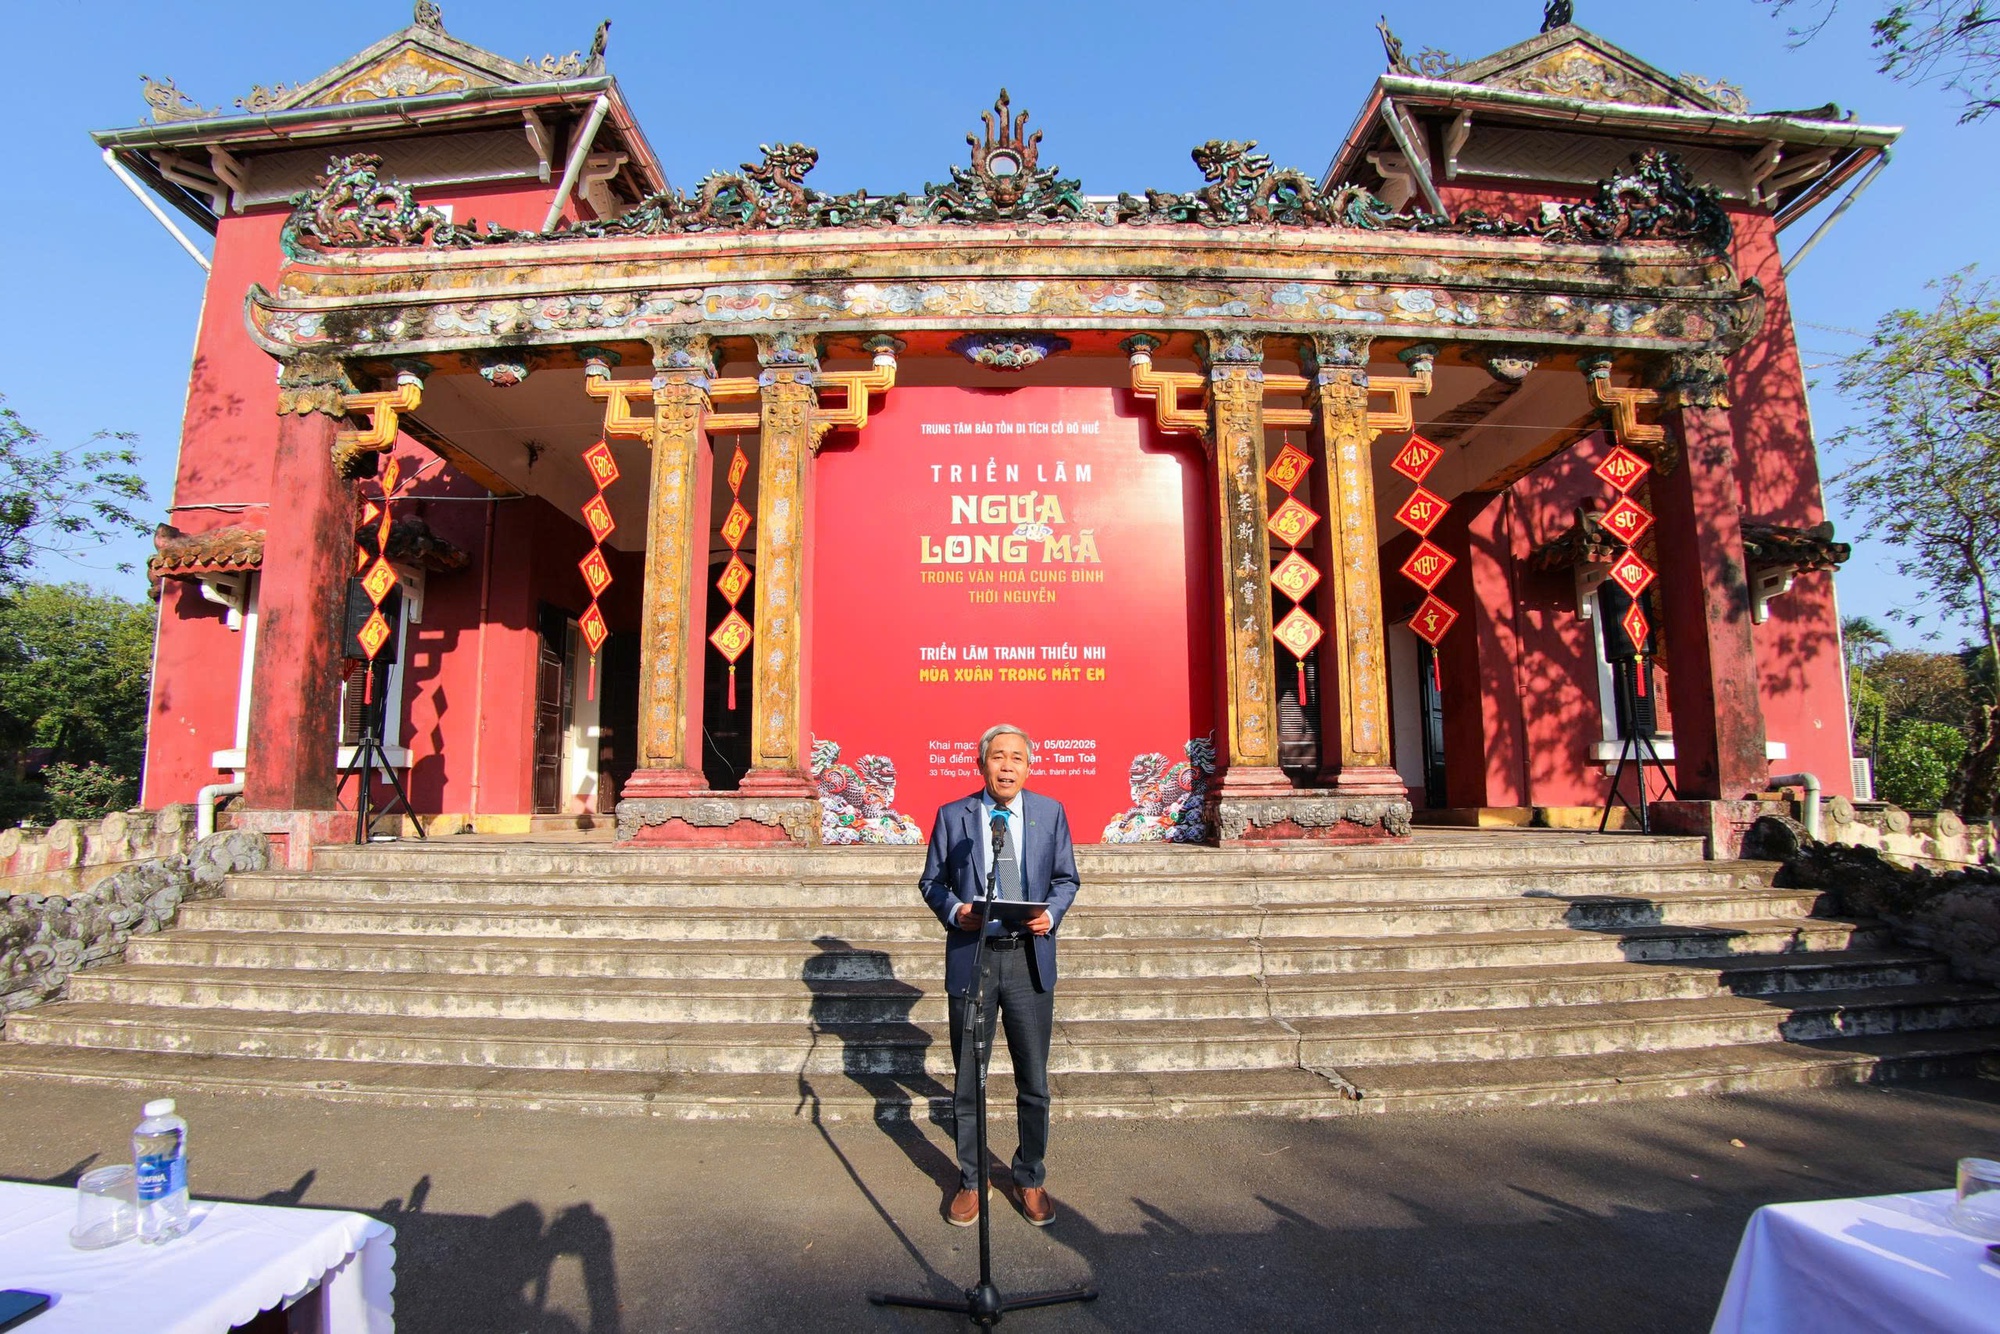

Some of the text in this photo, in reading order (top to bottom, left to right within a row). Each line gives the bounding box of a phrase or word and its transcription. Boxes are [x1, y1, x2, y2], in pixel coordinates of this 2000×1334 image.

[921, 423, 951, 434] TRUNG
[953, 421, 972, 434] TÂM
[975, 420, 993, 434] BẢO
[1016, 423, 1026, 434] DI
[1028, 420, 1049, 434] TÍCH
[1081, 419, 1100, 434] HUẾ
[592, 454, 613, 478] CHÚC
[931, 457, 1092, 483] TRIỂN LÃM
[1606, 457, 1635, 482] VẠN
[920, 529, 1102, 564] LONG MÃ
[1403, 446, 1429, 472] VẠN
[1423, 609, 1440, 632] Ý
[920, 568, 1104, 584] TRONG VĂN HOÁ CUNG ĐÌNH
[968, 586, 1056, 603] THỜI NGUYỄN
[920, 642, 1106, 660] TRIỂN LÃM TRANH THIẾU NHI
[919, 662, 1106, 682] MÙA XUÂN TRONG MẮT EM
[929, 740, 977, 751] Khai mạc:
[1044, 739, 1096, 749] 05/02/2026
[929, 752, 976, 765] Địa điểm:
[1053, 753, 1075, 763] Tam
[1078, 752, 1096, 763] Toà
[957, 769, 971, 777] Duy
